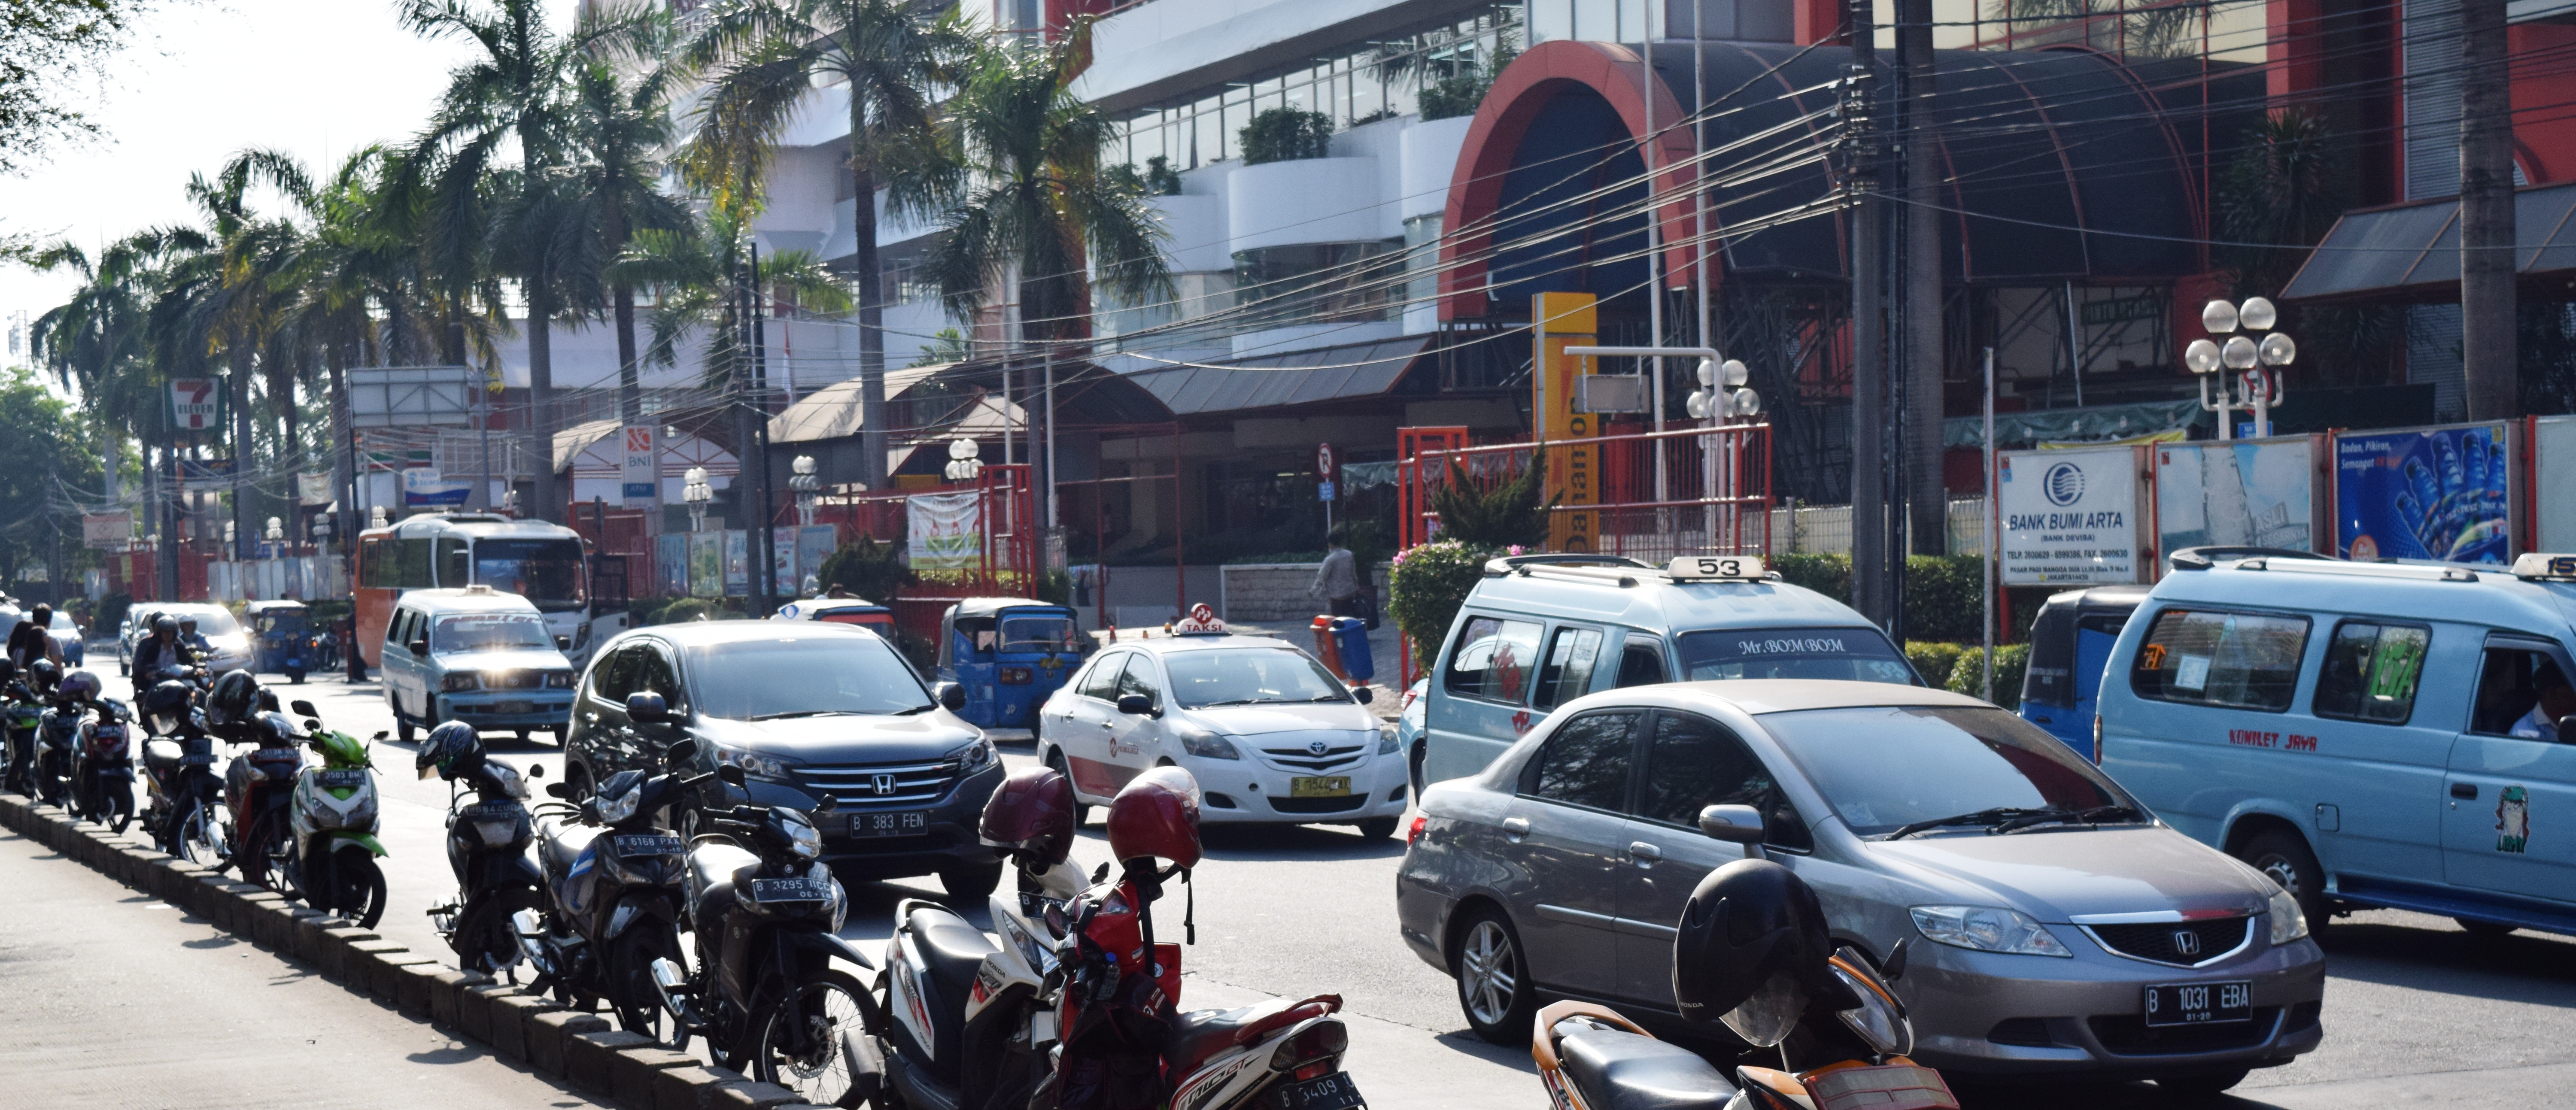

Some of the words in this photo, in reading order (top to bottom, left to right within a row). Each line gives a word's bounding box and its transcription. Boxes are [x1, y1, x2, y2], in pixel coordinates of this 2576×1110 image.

[176, 381, 213, 428] 7
[178, 404, 214, 414] ELEVEN
[629, 456, 651, 467] BNI
[2009, 514, 2046, 531] BANK
[2049, 513, 2083, 529] BUMI
[2085, 512, 2123, 528] ARTA
[2041, 535, 2064, 543] (BANK
[2065, 534, 2095, 543] DEVISA)
[1697, 559, 1741, 576] 53
[1805, 639, 1846, 652] BOM
[1006, 704, 1016, 714] JP
[2284, 734, 2318, 752] JAYA
[1294, 779, 1300, 790] B
[854, 816, 861, 830] B
[874, 814, 894, 829] 383
[903, 813, 924, 828] FEN
[631, 837, 655, 846] 6168
[756, 882, 764, 892] B
[773, 880, 803, 891] 3295
[1022, 895, 1030, 905] B
[986, 958, 1006, 979] HONDA
[2149, 989, 2158, 1013] B
[2179, 986, 2208, 1010] 1031
[2221, 984, 2248, 1008] EBA
[1281, 1090, 1291, 1107] B
